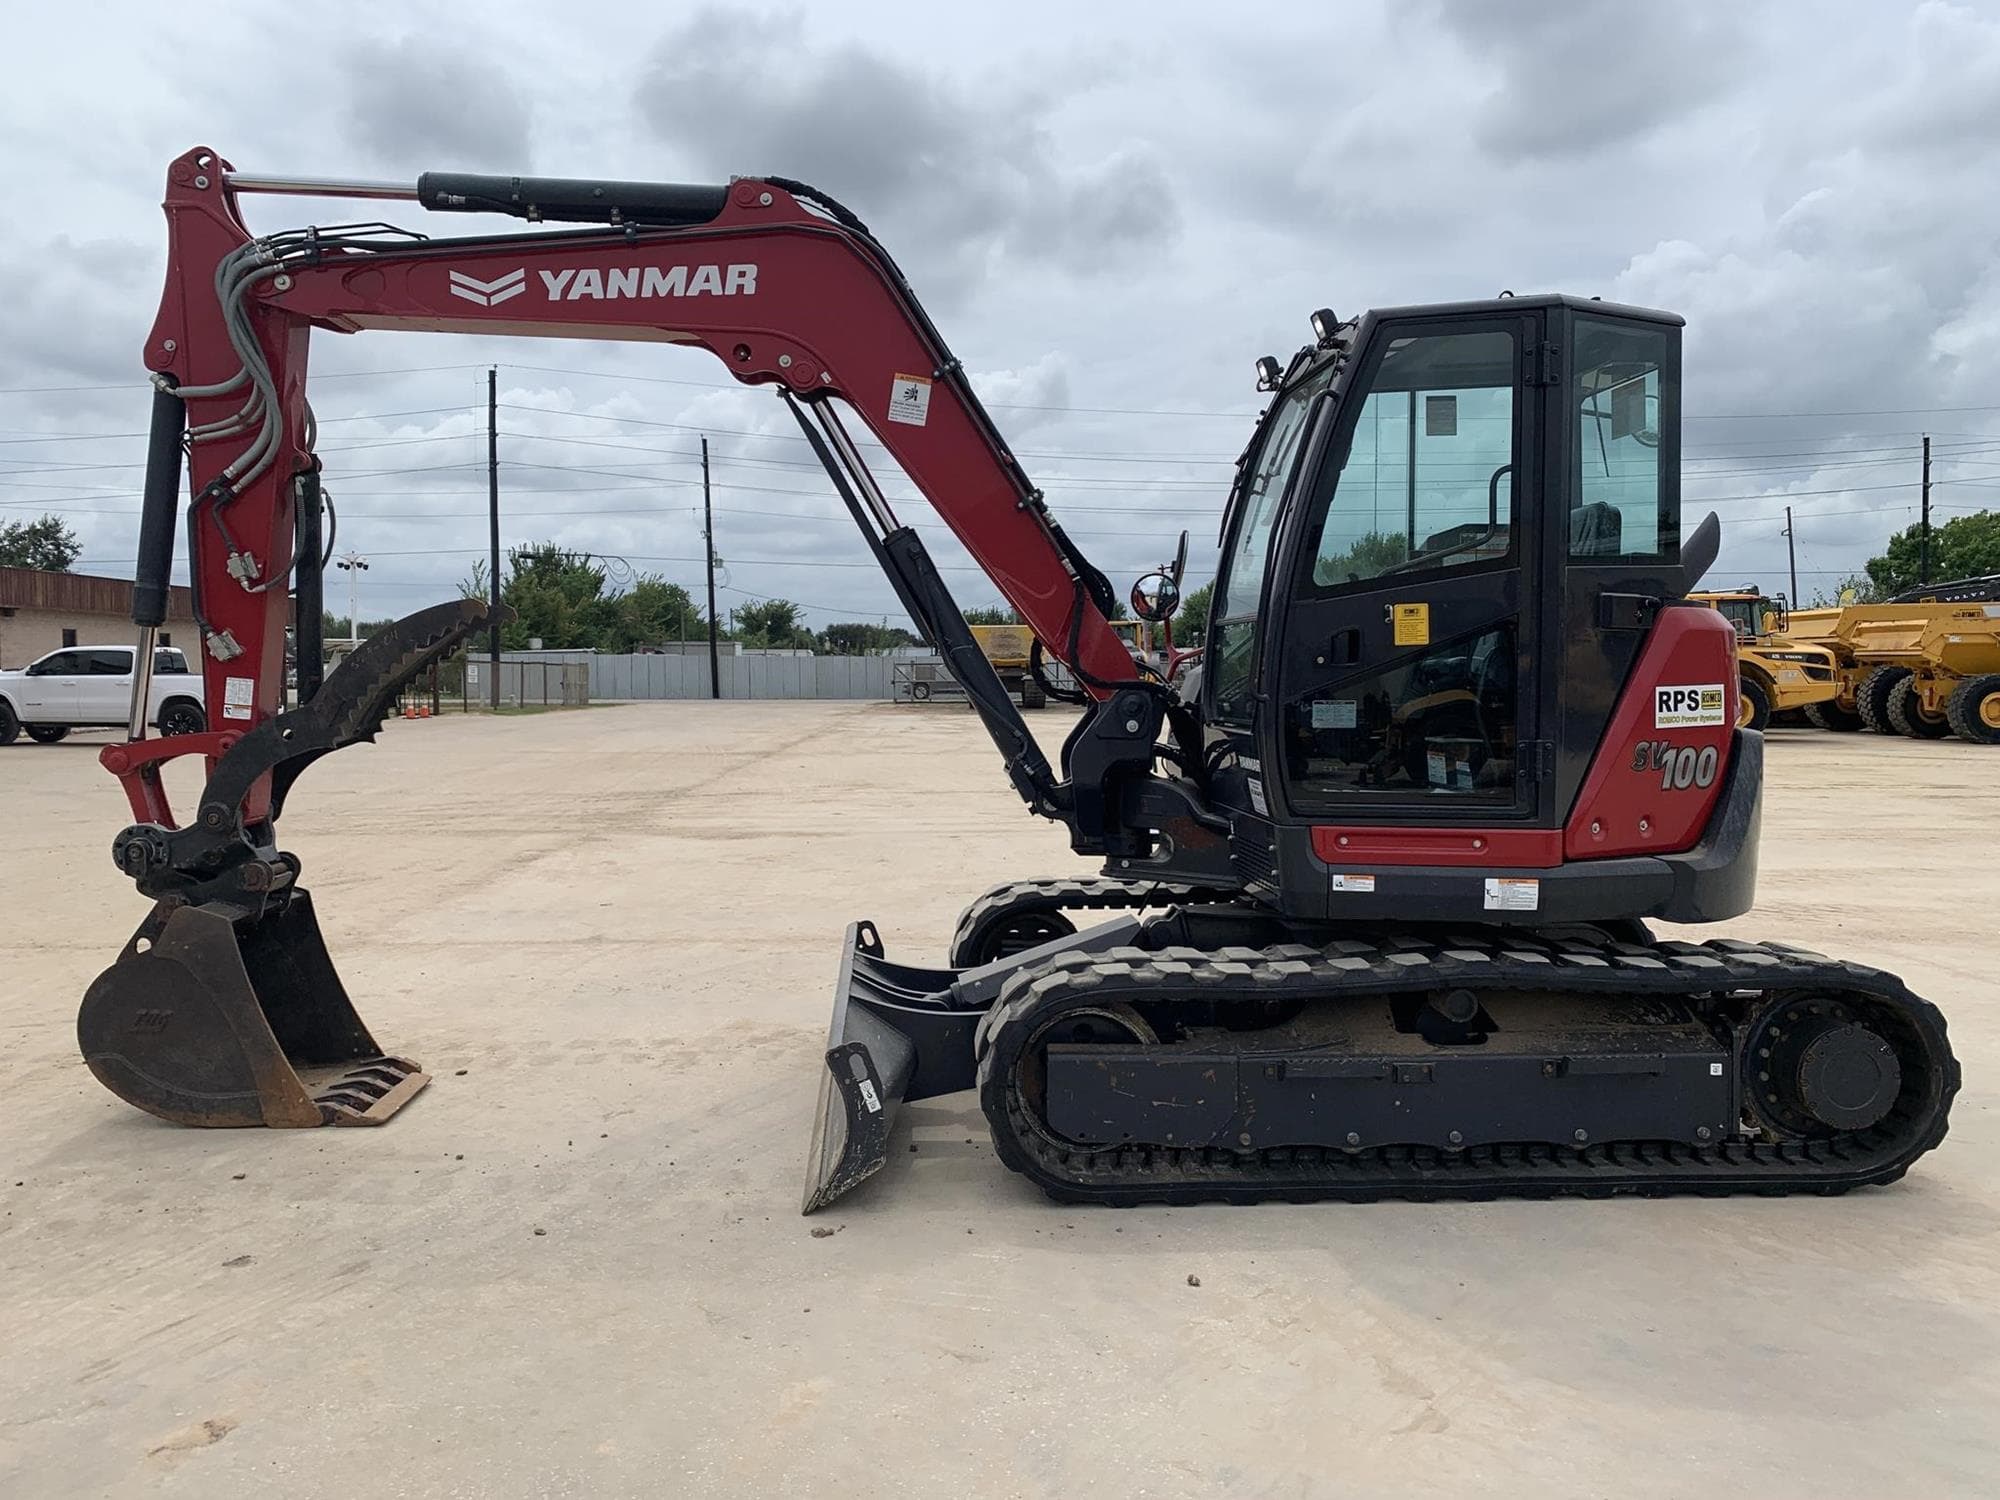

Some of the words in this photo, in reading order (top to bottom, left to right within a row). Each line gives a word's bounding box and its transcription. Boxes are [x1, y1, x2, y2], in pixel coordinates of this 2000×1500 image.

[538, 263, 758, 301] YANMAR
[1944, 590, 1985, 602] VOLVO
[1658, 690, 1700, 713] RPS
[1631, 740, 1719, 791] SV100
